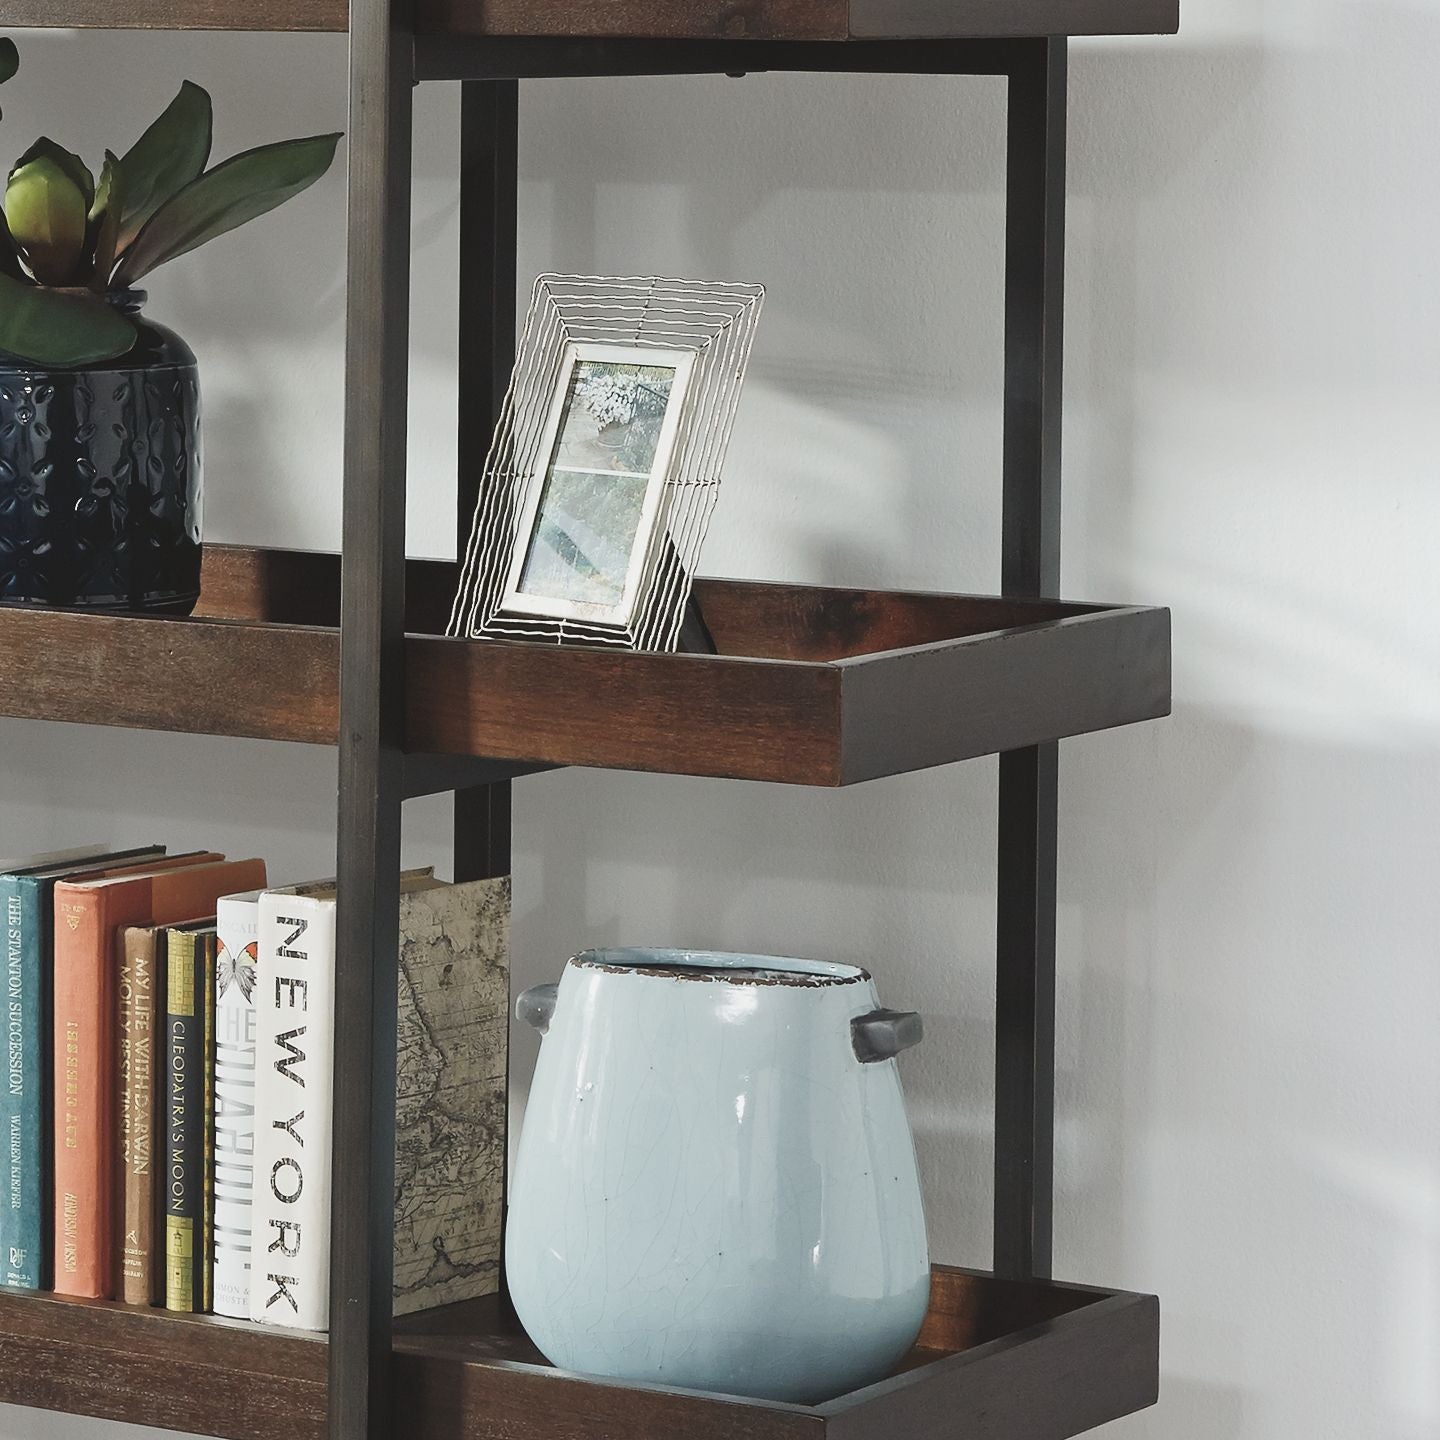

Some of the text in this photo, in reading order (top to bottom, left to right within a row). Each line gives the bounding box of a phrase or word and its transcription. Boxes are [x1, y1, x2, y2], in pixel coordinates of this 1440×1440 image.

[8, 895, 24, 1097] THE STANTON SUCCESSION
[119, 965, 132, 1033] MOLLY
[132, 957, 150, 1175] MY LIFE WITH DARWIN
[10, 1113, 22, 1209] WARREN KIEFER
[171, 1020, 186, 1211] CLEOPATRA'S MOON
[265, 915, 309, 1314] NEW YORK
